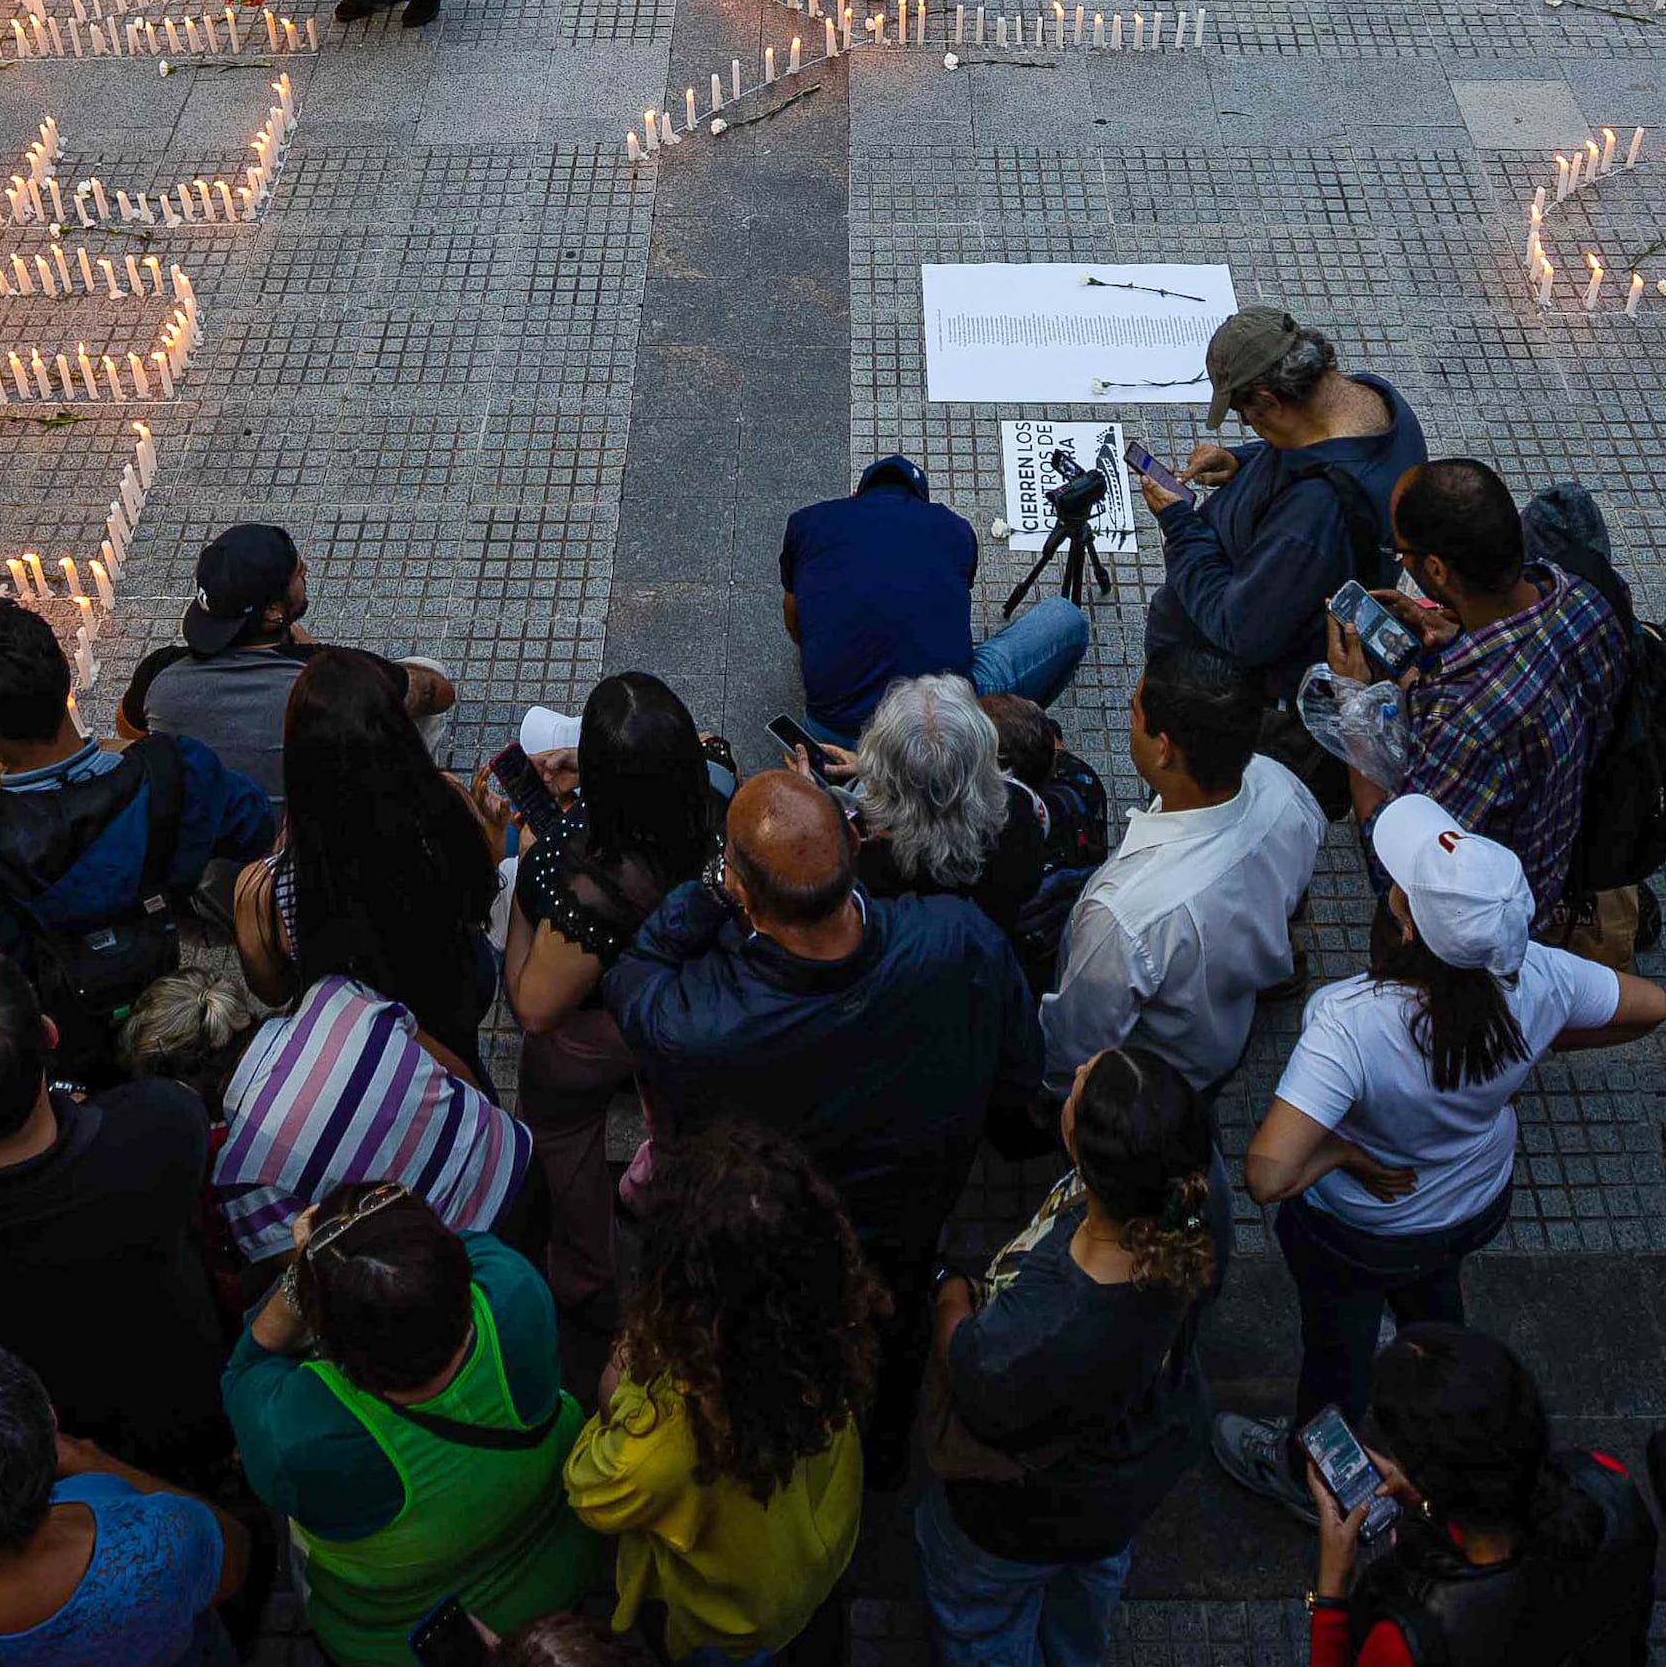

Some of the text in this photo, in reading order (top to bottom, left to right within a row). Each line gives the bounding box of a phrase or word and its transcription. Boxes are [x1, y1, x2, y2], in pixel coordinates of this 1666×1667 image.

[1035, 424, 1054, 446] DE
[1015, 422, 1040, 533] CIERREN LOS
